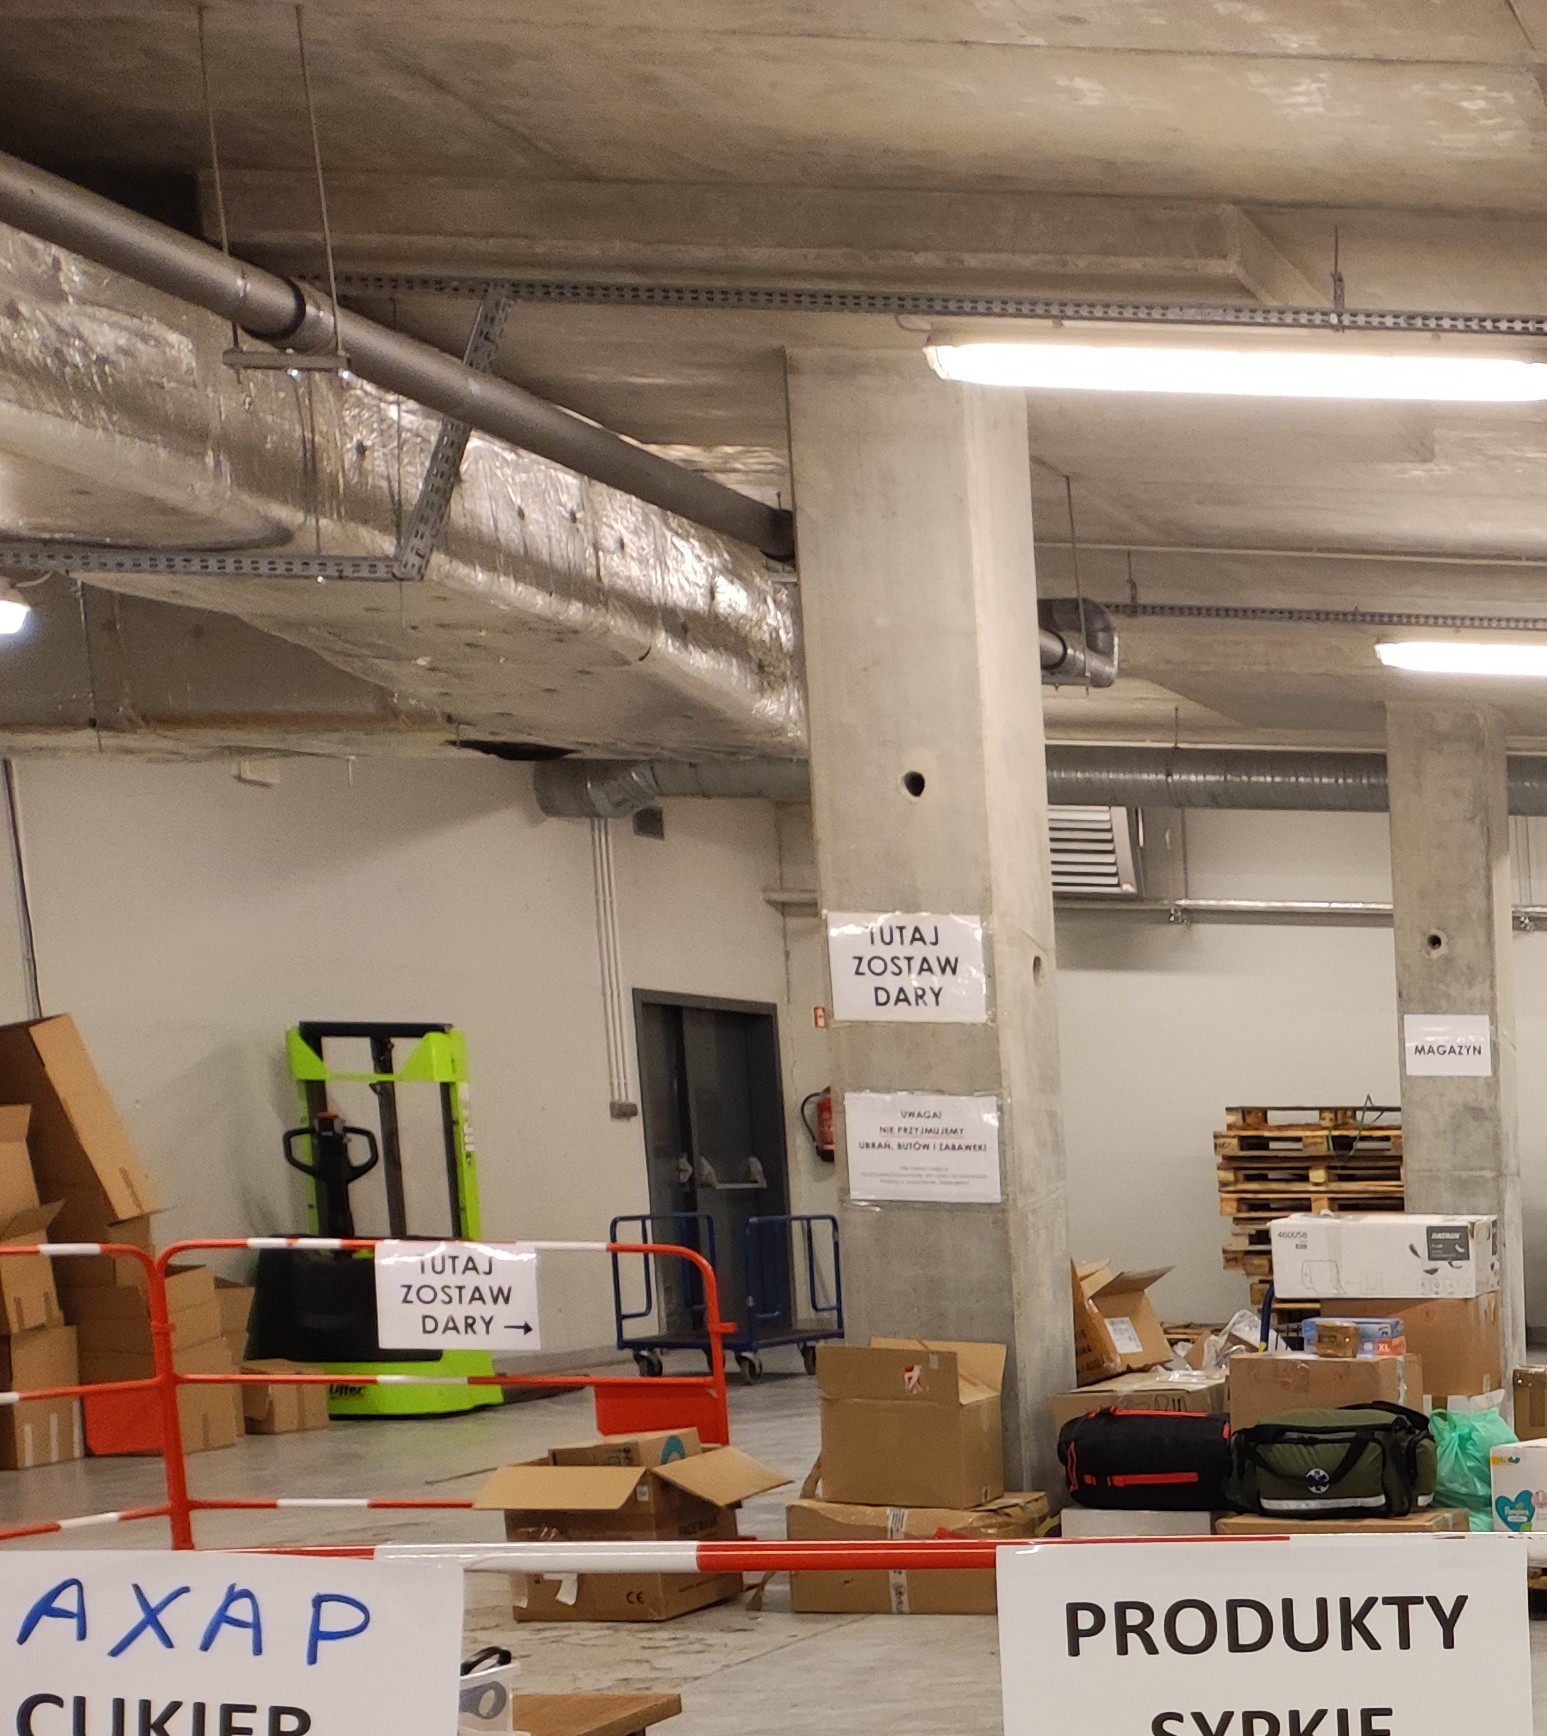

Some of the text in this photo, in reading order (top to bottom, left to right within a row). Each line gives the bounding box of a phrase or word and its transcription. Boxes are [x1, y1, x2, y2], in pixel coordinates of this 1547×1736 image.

[868, 925, 939, 946] TUTAJ
[852, 956, 959, 976] ZOSTAW
[874, 986, 943, 1007] DARY
[1414, 1044, 1482, 1056] MAGAZYN
[879, 1126, 895, 1135] NIE
[418, 1255, 493, 1275] TUTAJ
[400, 1284, 512, 1305] ZOSTAW
[421, 1314, 494, 1335] DARY
[1377, 1343, 1391, 1352] XL
[16, 1577, 371, 1665] АХАР
[1065, 1595, 1469, 1657] PRODUKTY
